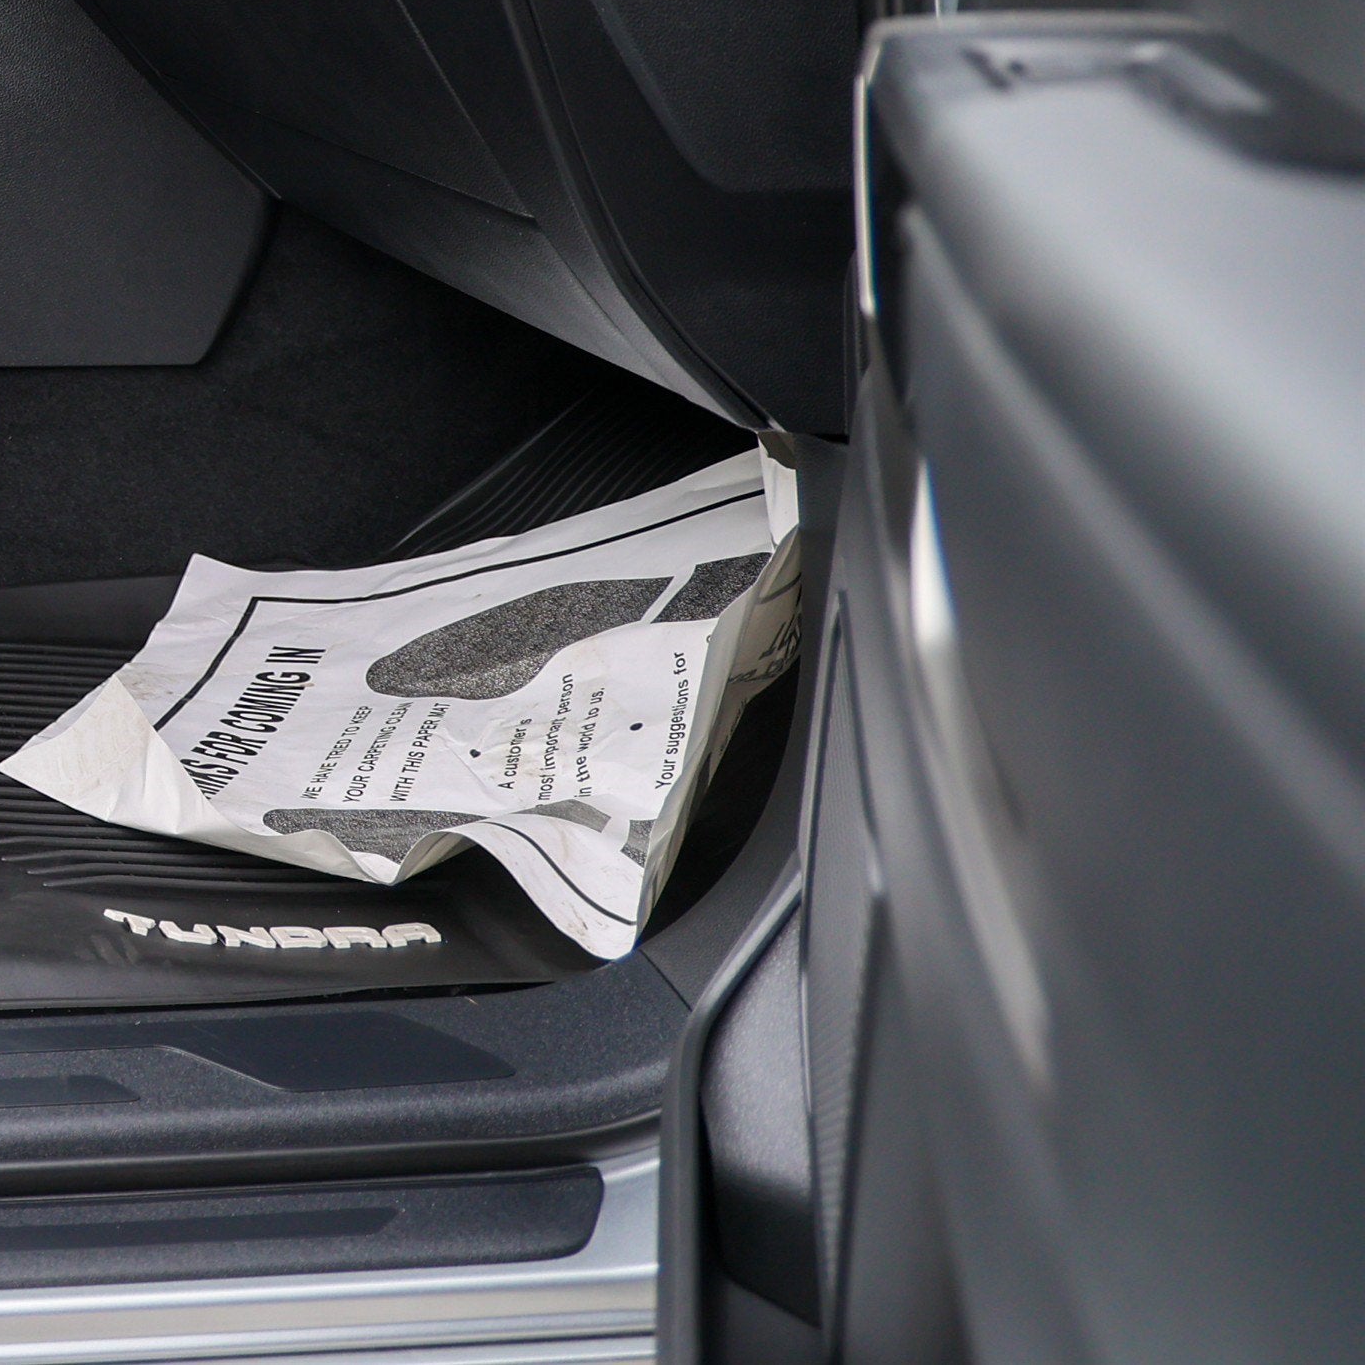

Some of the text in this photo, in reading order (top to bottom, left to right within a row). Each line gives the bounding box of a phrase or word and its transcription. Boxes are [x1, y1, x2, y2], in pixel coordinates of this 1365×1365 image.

[179, 645, 327, 800] NKS FOR COMING IN
[341, 726, 361, 737] TO
[349, 705, 373, 725] KEEP
[537, 773, 556, 801] most
[556, 673, 574, 716] person
[654, 651, 690, 790] Your suggestions for
[342, 701, 415, 803] YOUR CARPETING CLEAN
[389, 702, 451, 802] WITH THIS PAPER MAT
[503, 727, 527, 777] customer
[573, 687, 606, 798] in the world to us.
[300, 786, 323, 800] WE
[310, 762, 338, 783] HAVE
[497, 781, 515, 790] A
[103, 908, 443, 950] TUNDRA
